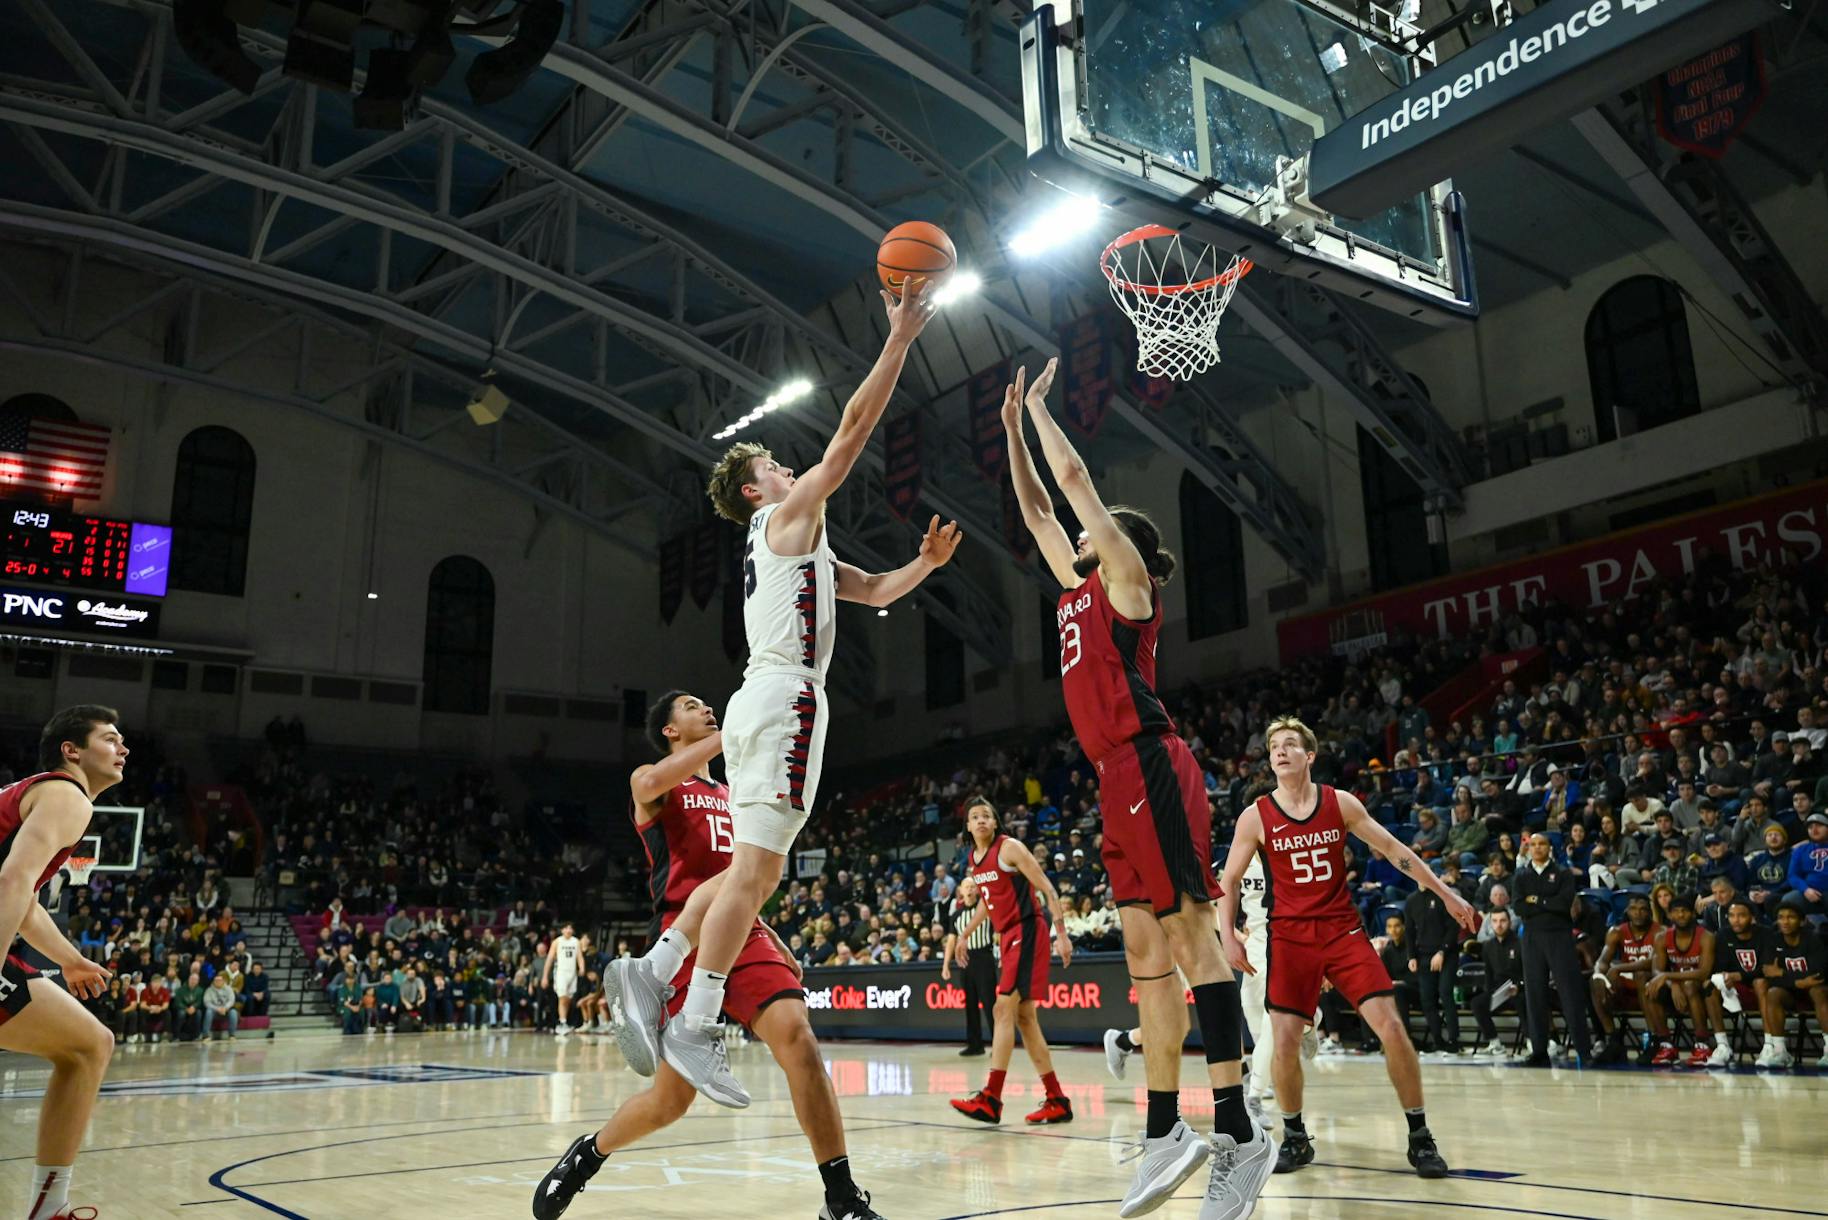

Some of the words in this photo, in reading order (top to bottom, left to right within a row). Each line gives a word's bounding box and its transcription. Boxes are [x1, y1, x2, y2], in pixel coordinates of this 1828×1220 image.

[1361, 0, 1612, 150] Independence
[13, 510, 49, 528] 12:43
[53, 540, 74, 554] 21
[1424, 575, 1547, 638] THE
[1580, 507, 1828, 608] PALES
[3, 593, 63, 619] PNC
[682, 794, 730, 813] HARVA
[706, 813, 735, 853] 15
[1272, 828, 1340, 852] HARVARD
[973, 870, 999, 885] ARVARD
[1290, 847, 1333, 884] 55
[981, 886, 994, 910] 2
[1740, 952, 1753, 967] H
[831, 985, 865, 1009] Coke
[866, 985, 911, 1009] Ever?
[926, 983, 966, 1009] Coke
[1034, 983, 1101, 1009] UGAR
